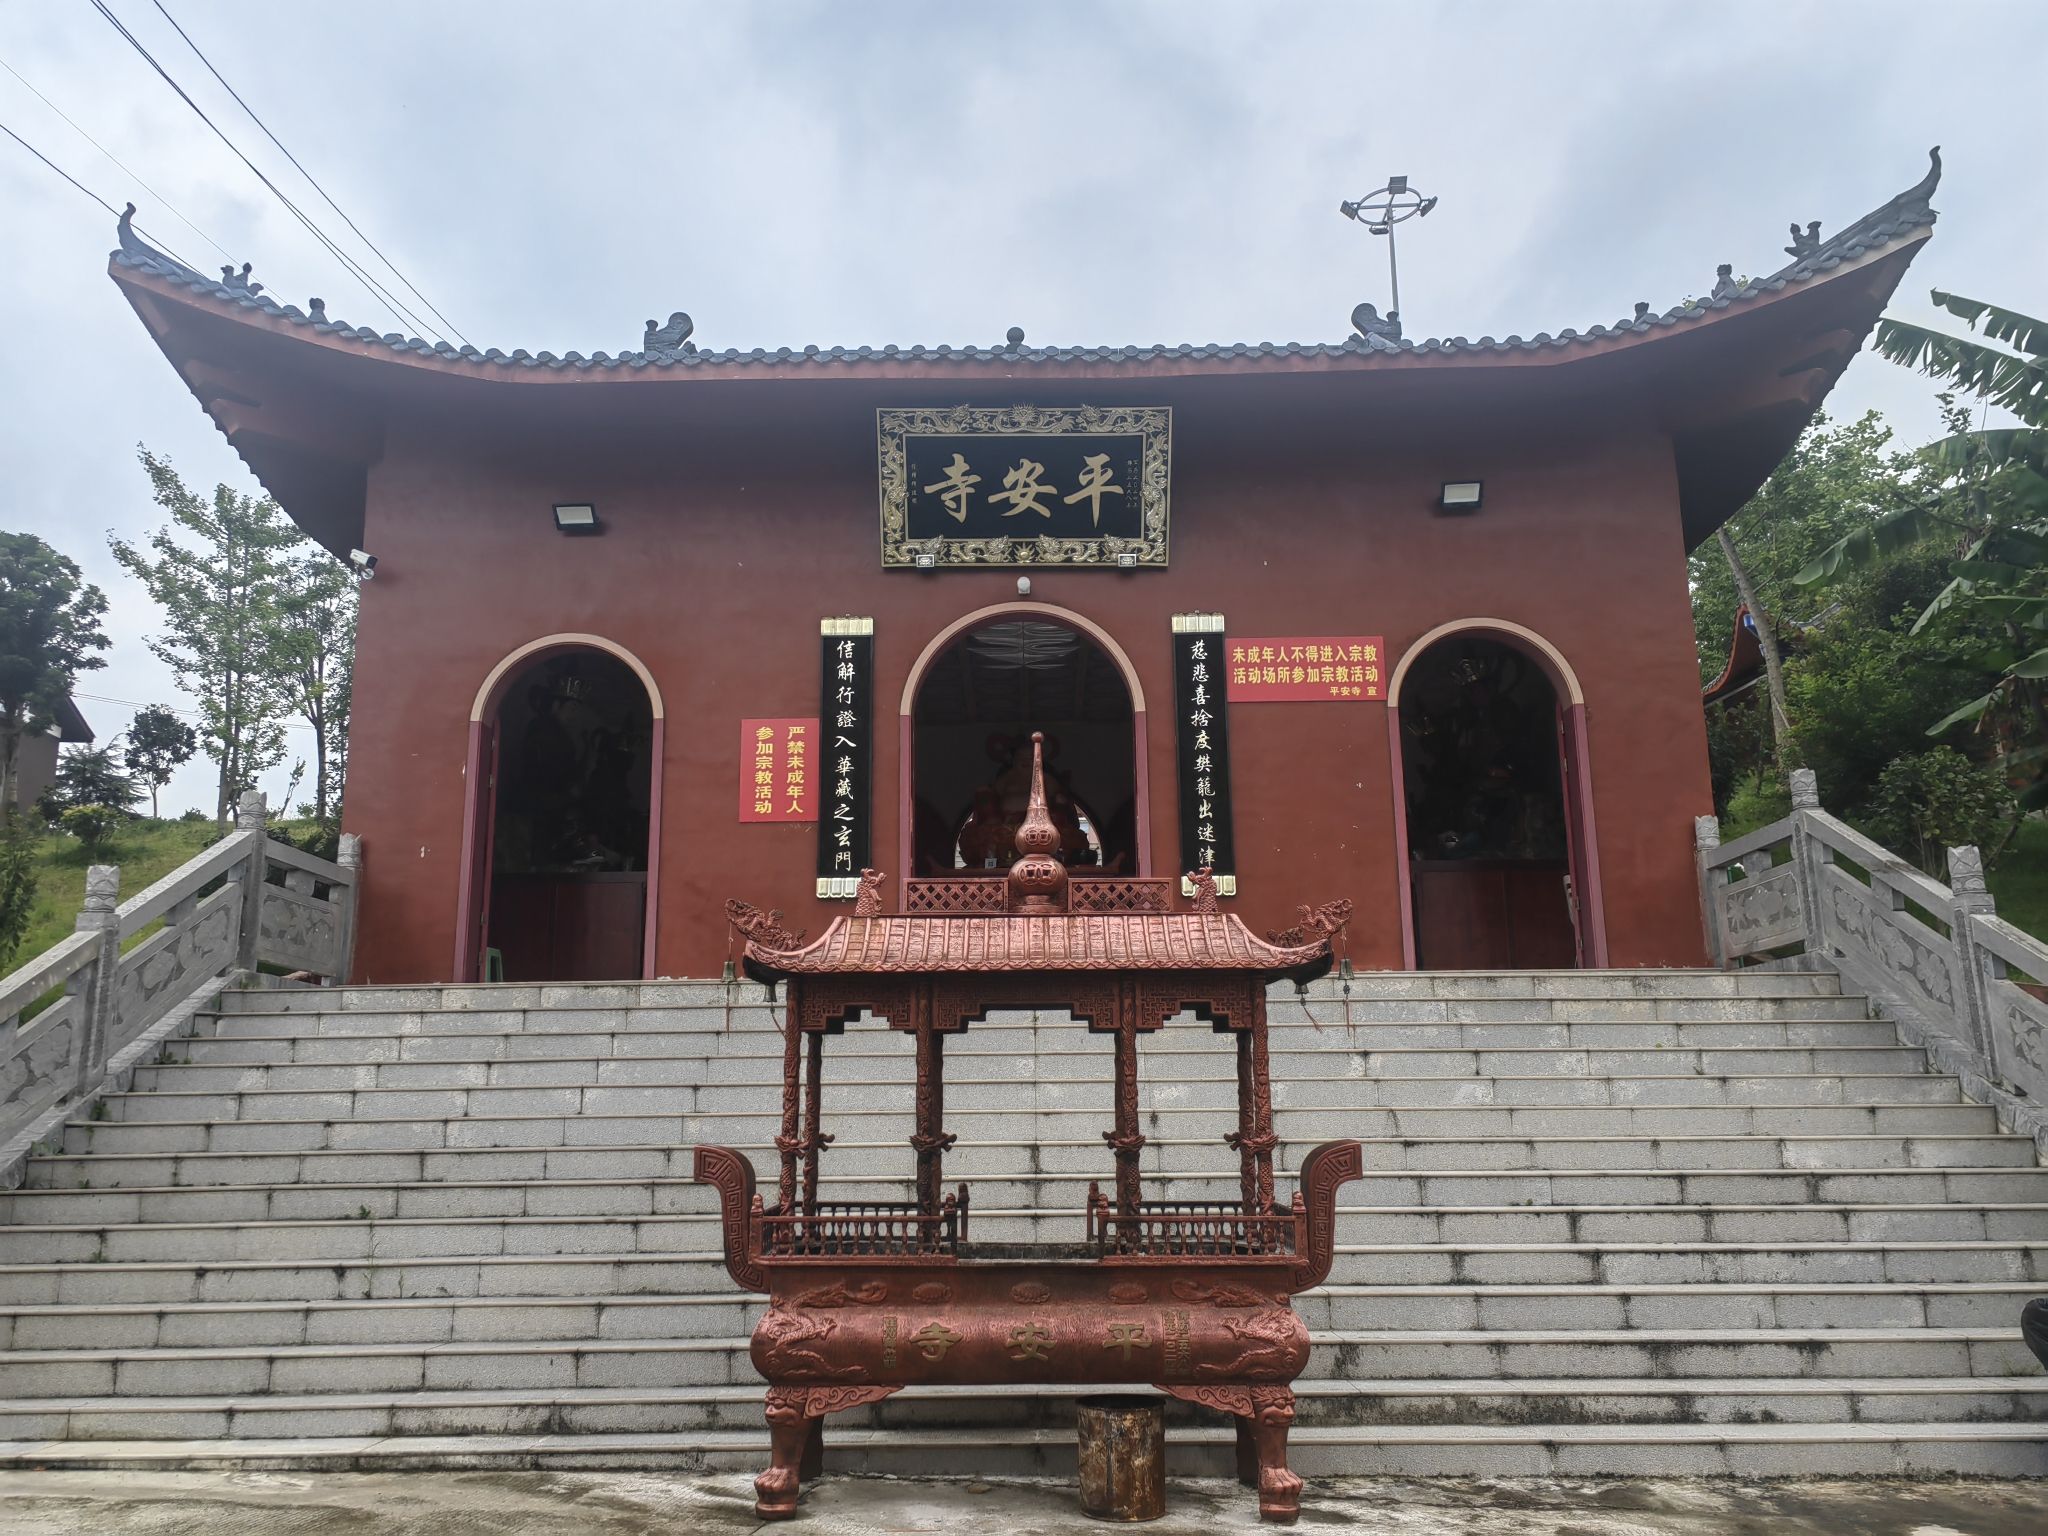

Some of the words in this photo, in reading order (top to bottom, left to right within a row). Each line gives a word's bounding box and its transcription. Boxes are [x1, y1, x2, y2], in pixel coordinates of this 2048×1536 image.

[923, 452, 1126, 529] 平安寺
[1232, 644, 1378, 664] 未成年人不得进入宗教
[1233, 665, 1379, 685] 活动场所参加宗教活动
[1330, 686, 1361, 697] 平安寺
[754, 726, 774, 814] 参加宗教活动
[786, 726, 806, 813] 严禁未成年人
[833, 640, 857, 872] 信解行證入華藏之玄門
[909, 1321, 1152, 1362] 平安寺
